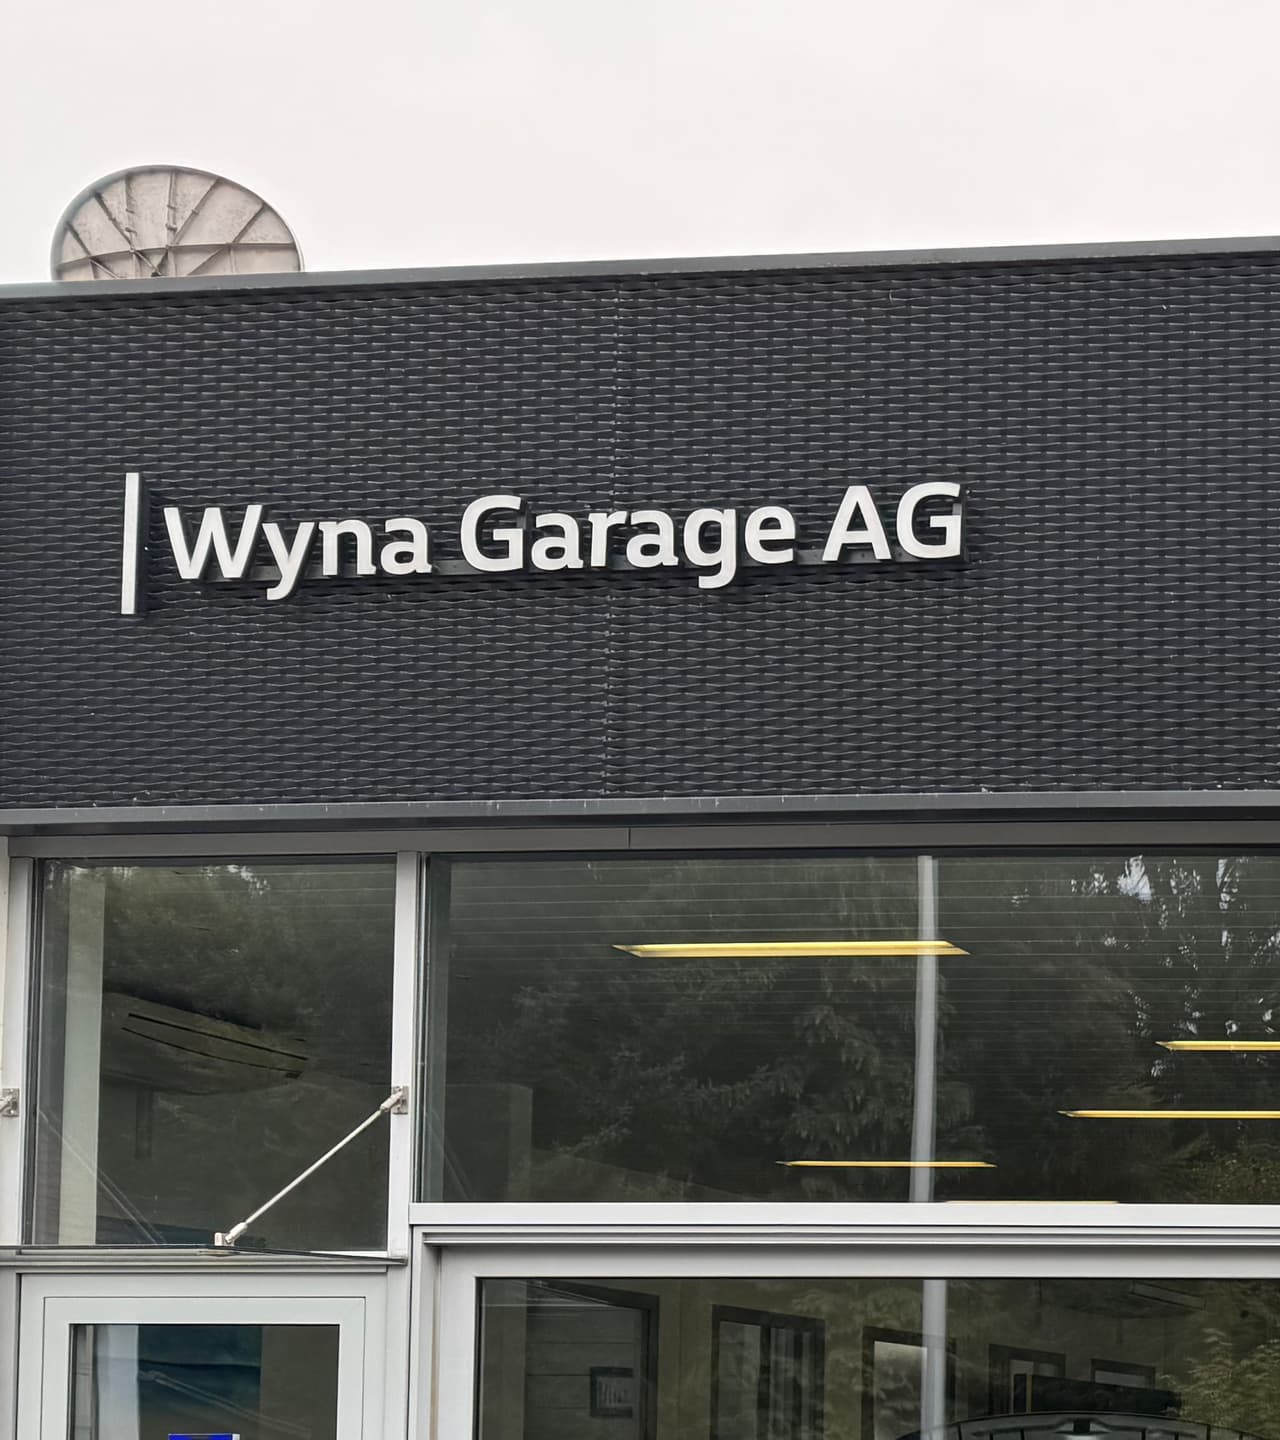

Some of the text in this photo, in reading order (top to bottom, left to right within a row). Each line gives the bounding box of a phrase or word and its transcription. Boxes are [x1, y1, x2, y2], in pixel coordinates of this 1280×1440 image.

[163, 481, 963, 601] Wyna Garage AG
